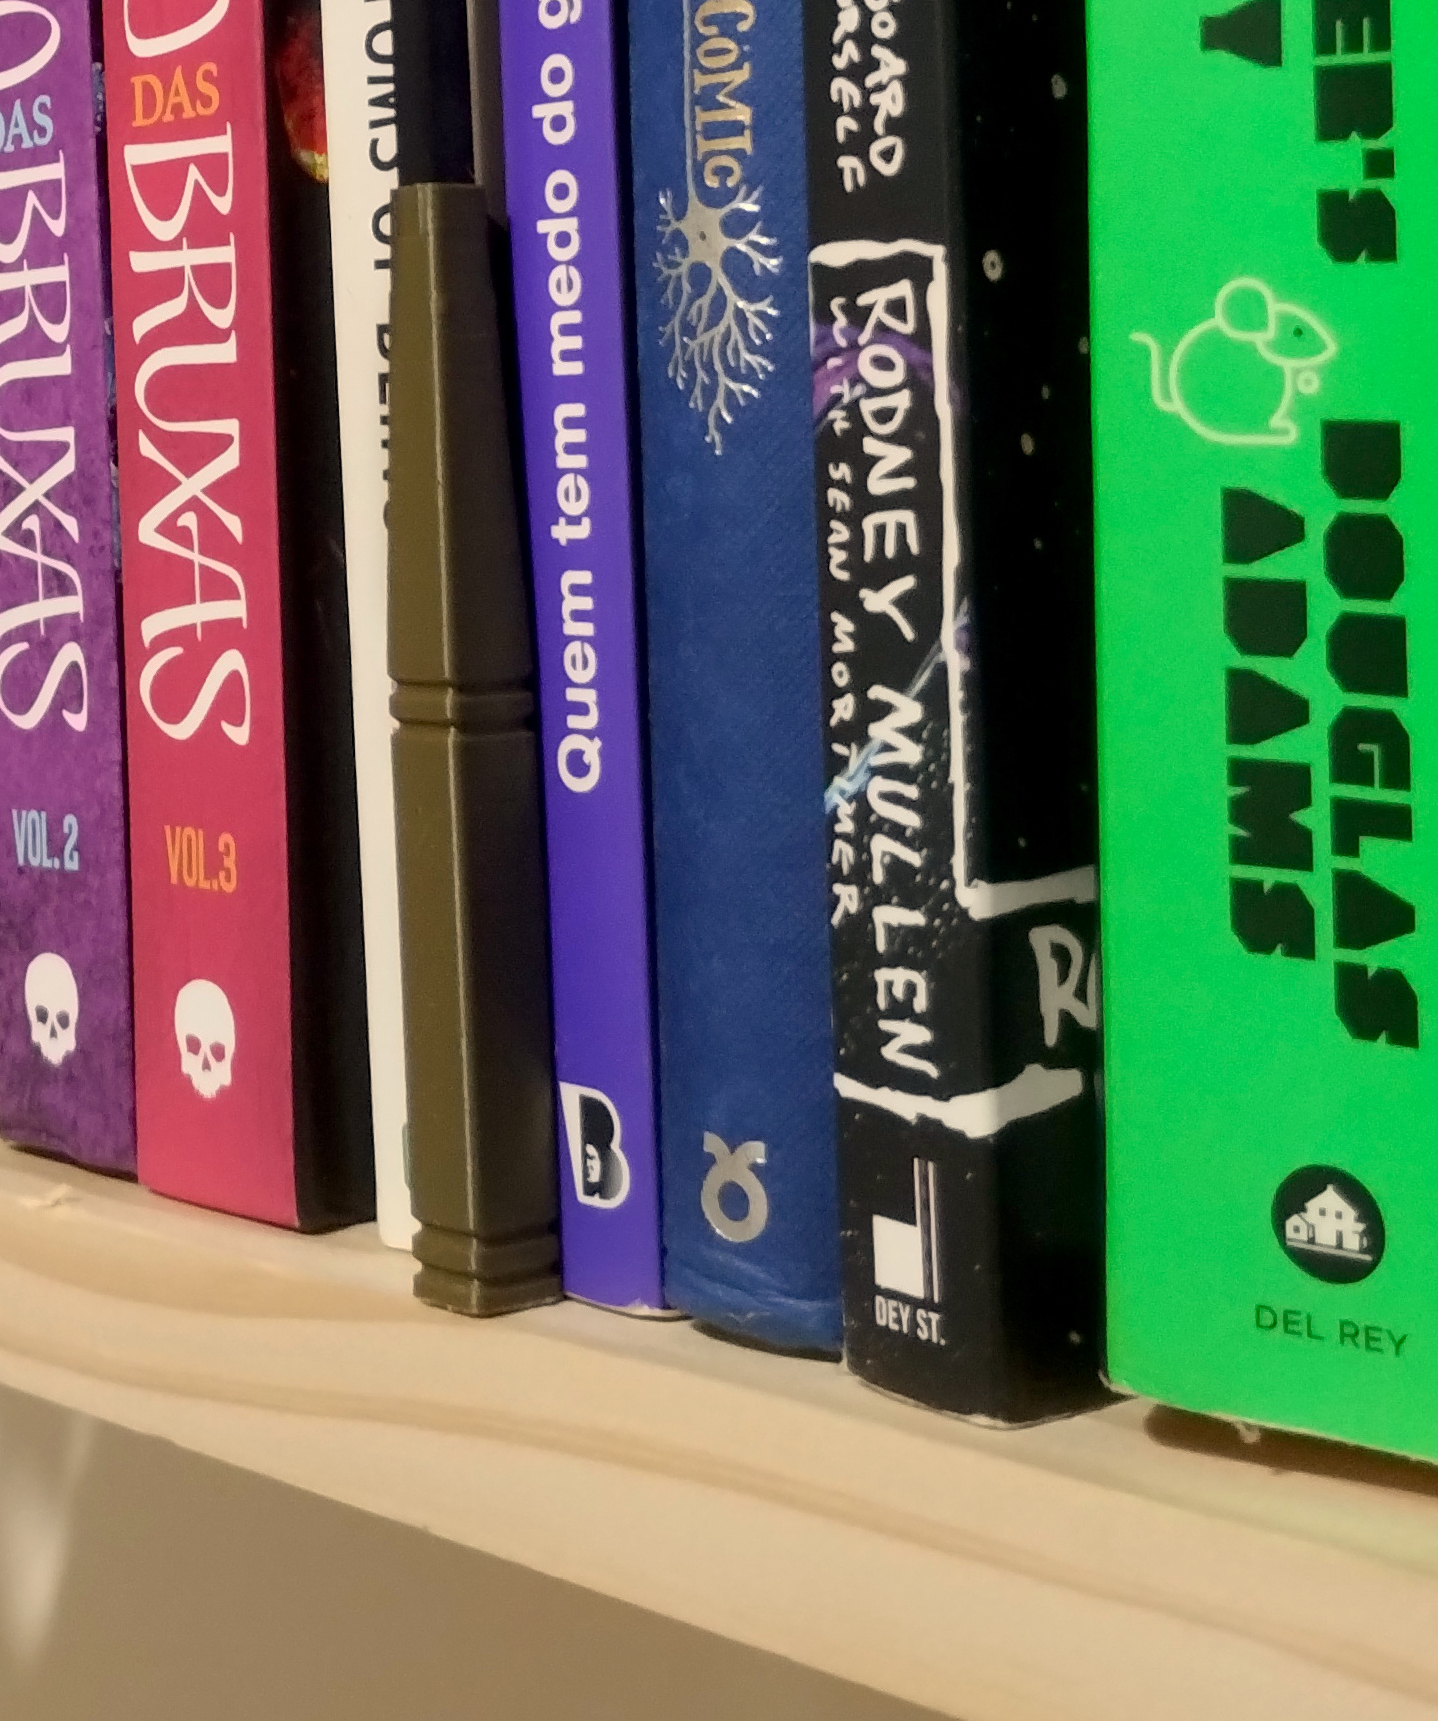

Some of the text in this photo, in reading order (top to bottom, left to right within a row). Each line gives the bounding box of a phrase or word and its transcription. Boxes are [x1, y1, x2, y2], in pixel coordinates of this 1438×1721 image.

[131, 62, 221, 128] DAS
[531, 55, 577, 146] do
[537, 169, 583, 376] medo
[124, 121, 252, 746] BRUXAS
[551, 401, 591, 546] tem
[826, 461, 853, 582] SEAN
[557, 569, 602, 794] Quem
[856, 279, 938, 1079] RODNEY MULLEN
[1221, 486, 1317, 961] ADAMS
[1321, 419, 1420, 1049] DOUGLAS
[874, 1294, 947, 1347] DEY ST.
[1254, 1303, 1409, 1358] DEL REY
